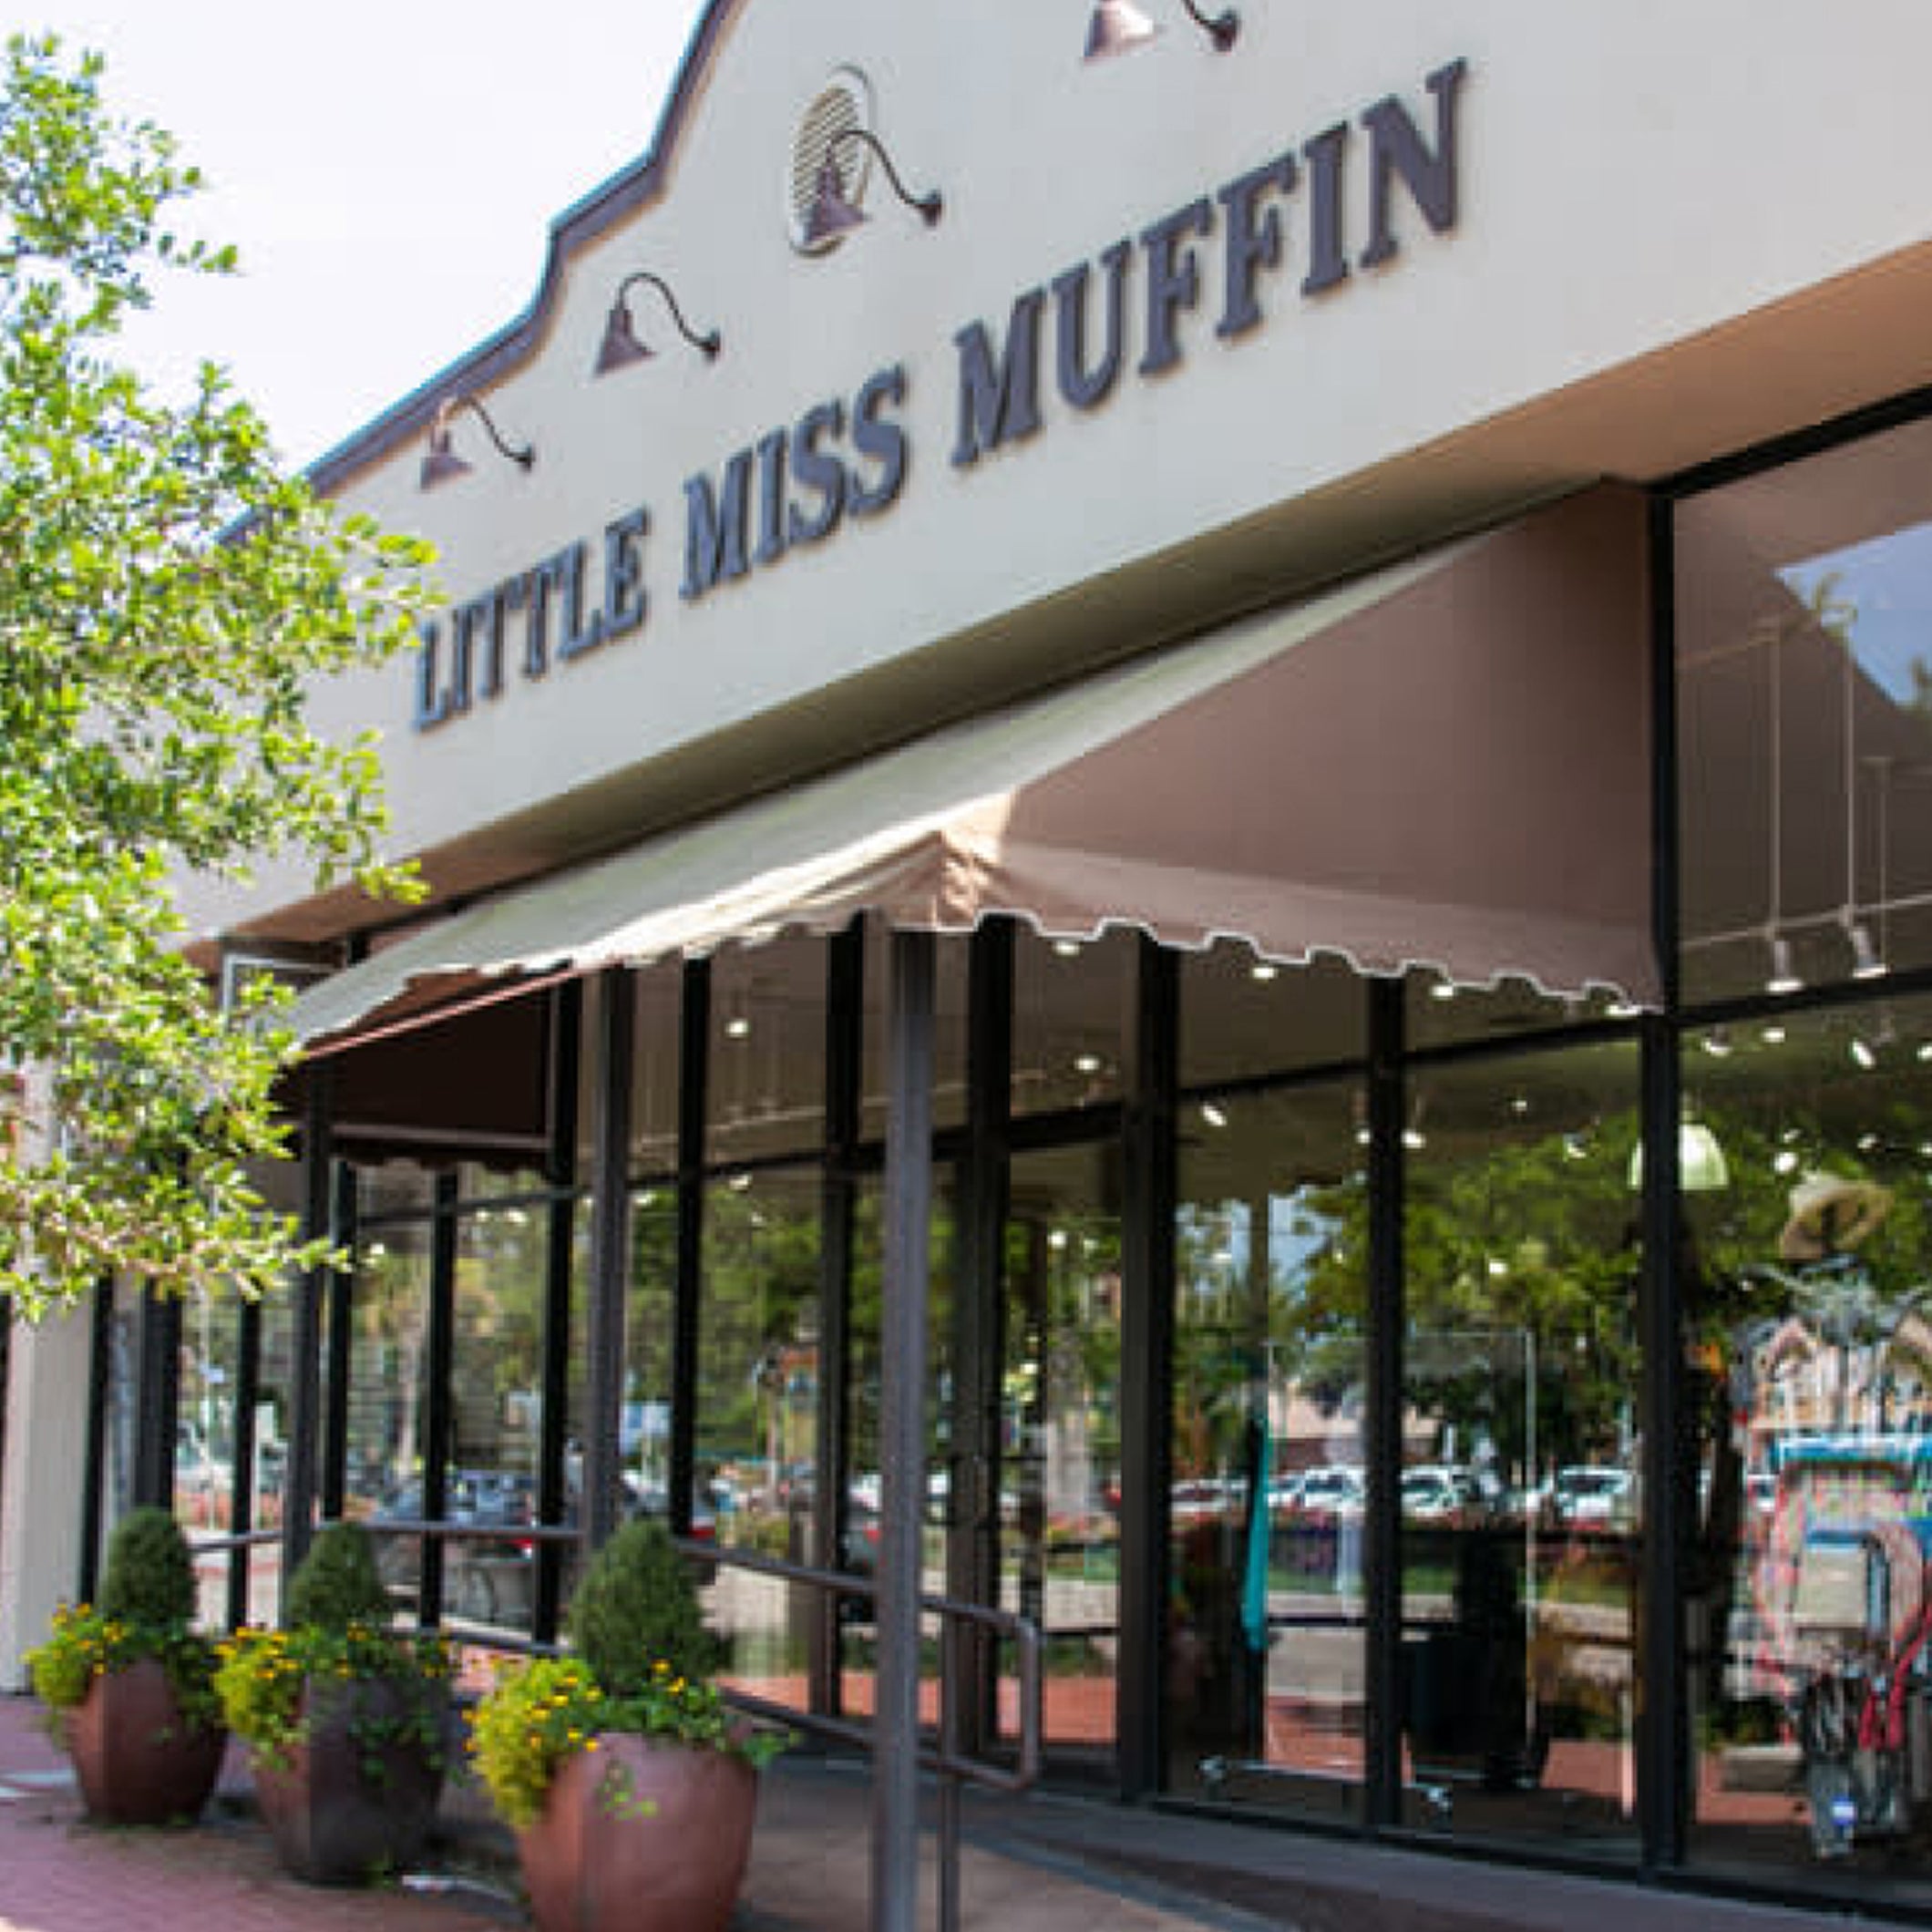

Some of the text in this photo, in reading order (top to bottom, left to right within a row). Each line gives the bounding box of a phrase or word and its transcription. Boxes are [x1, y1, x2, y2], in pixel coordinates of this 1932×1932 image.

[413, 57, 1471, 731] LITTLE MISS MUFFIN
